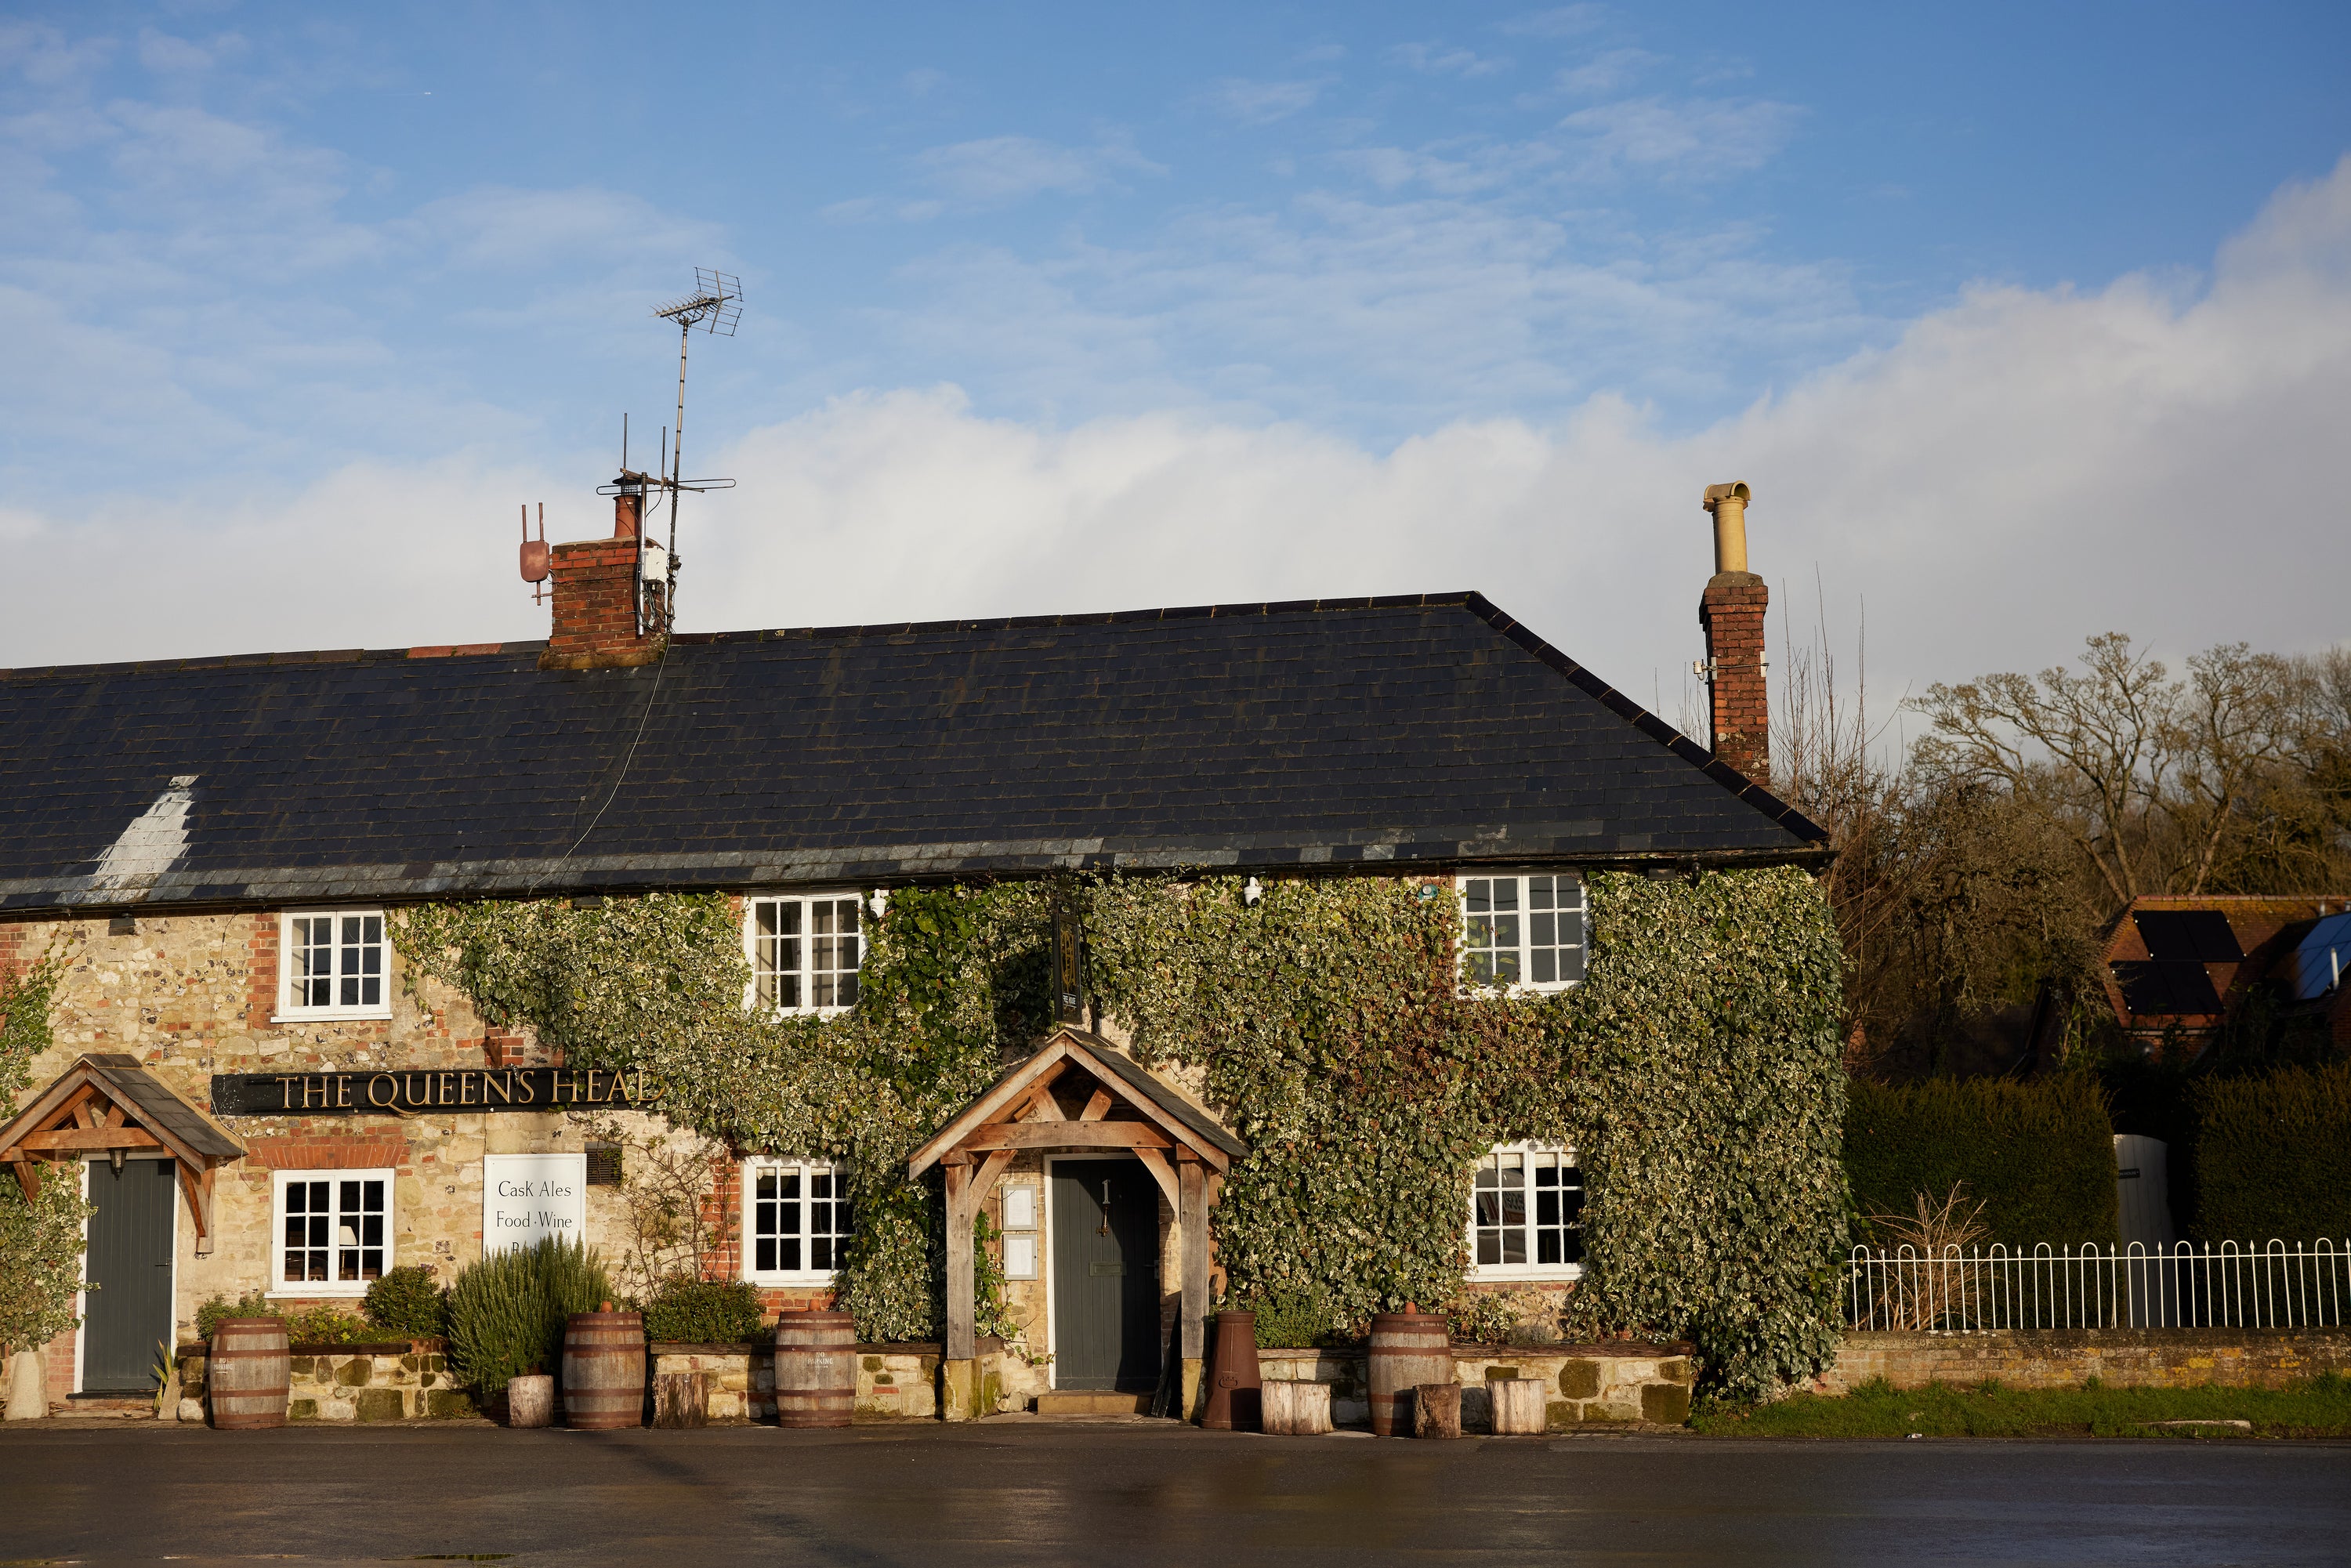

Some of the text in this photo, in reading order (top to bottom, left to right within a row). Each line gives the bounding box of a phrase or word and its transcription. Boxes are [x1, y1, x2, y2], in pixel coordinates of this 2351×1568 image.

[275, 1074, 352, 1108] THE
[539, 1180, 571, 1197] Ales
[497, 1211, 530, 1228] Food
